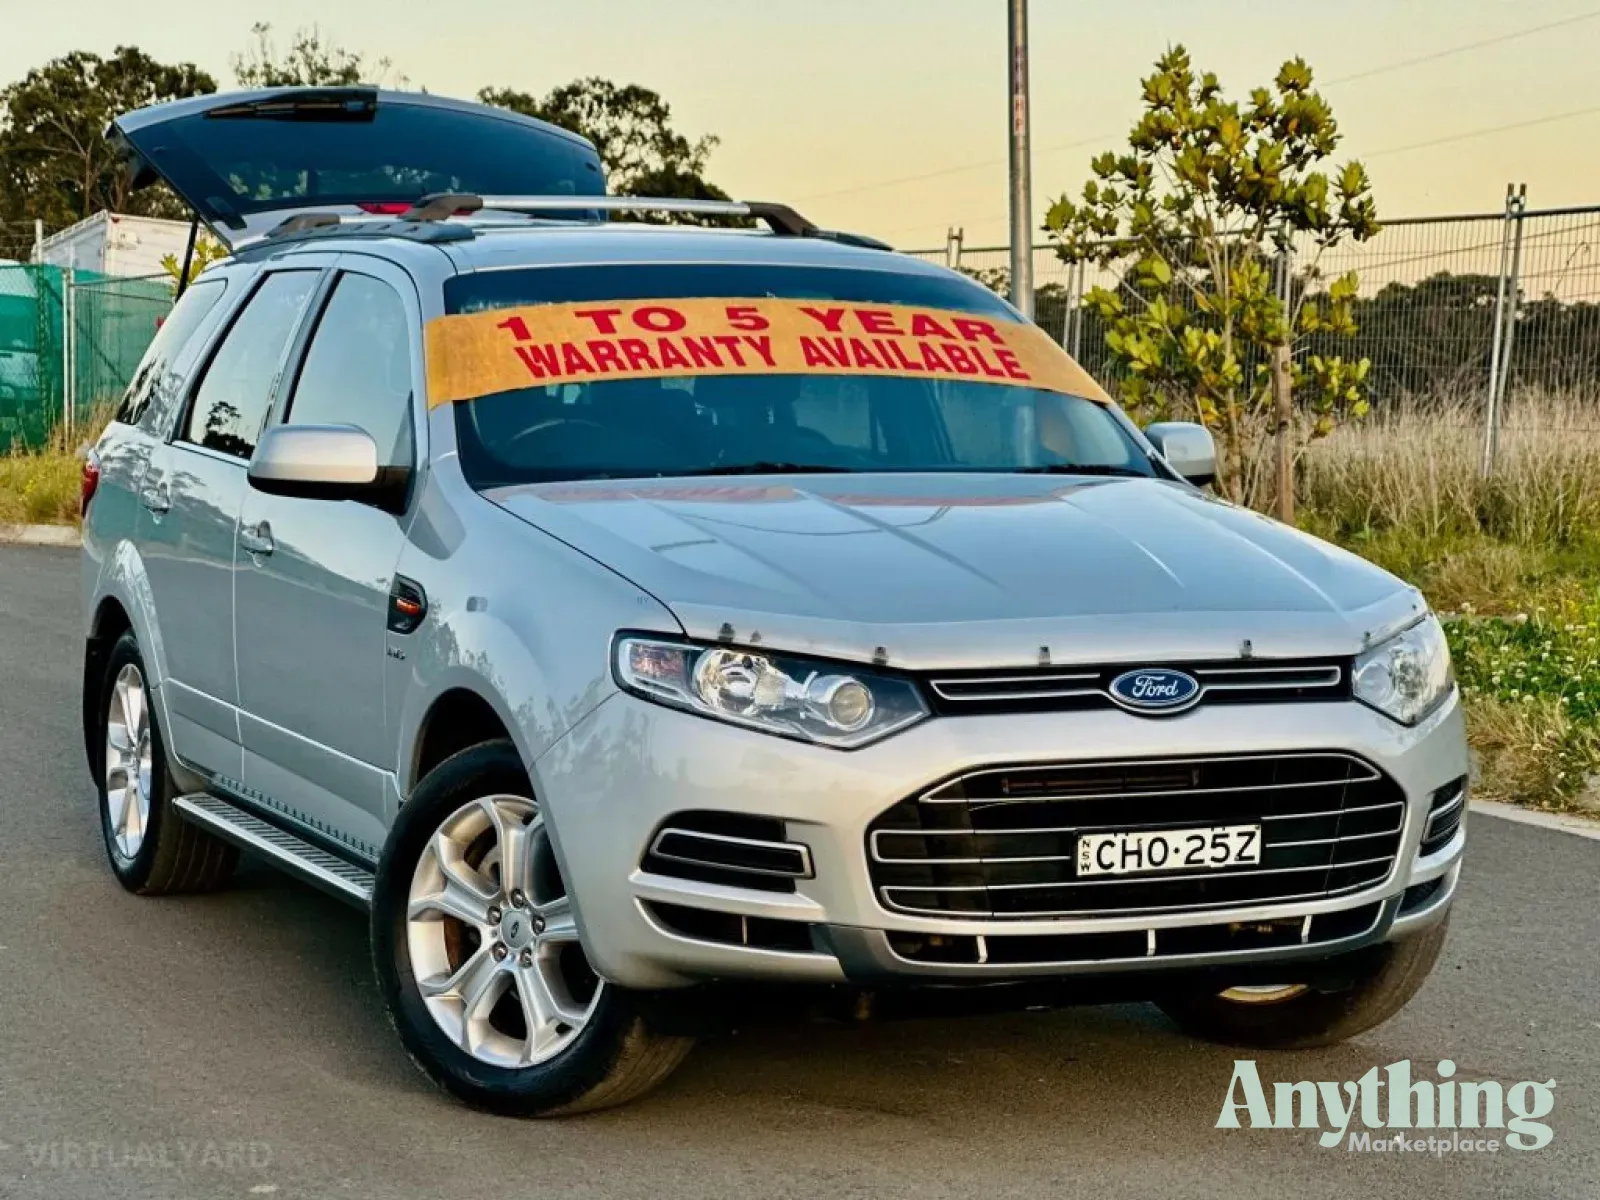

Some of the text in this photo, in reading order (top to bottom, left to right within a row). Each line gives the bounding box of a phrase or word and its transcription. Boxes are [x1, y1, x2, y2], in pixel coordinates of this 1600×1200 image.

[497, 307, 1006, 345] 1 TO 5 YEAR
[513, 336, 1031, 380] WARRANTY AVAILABLE
[1132, 674, 1180, 698] Ford
